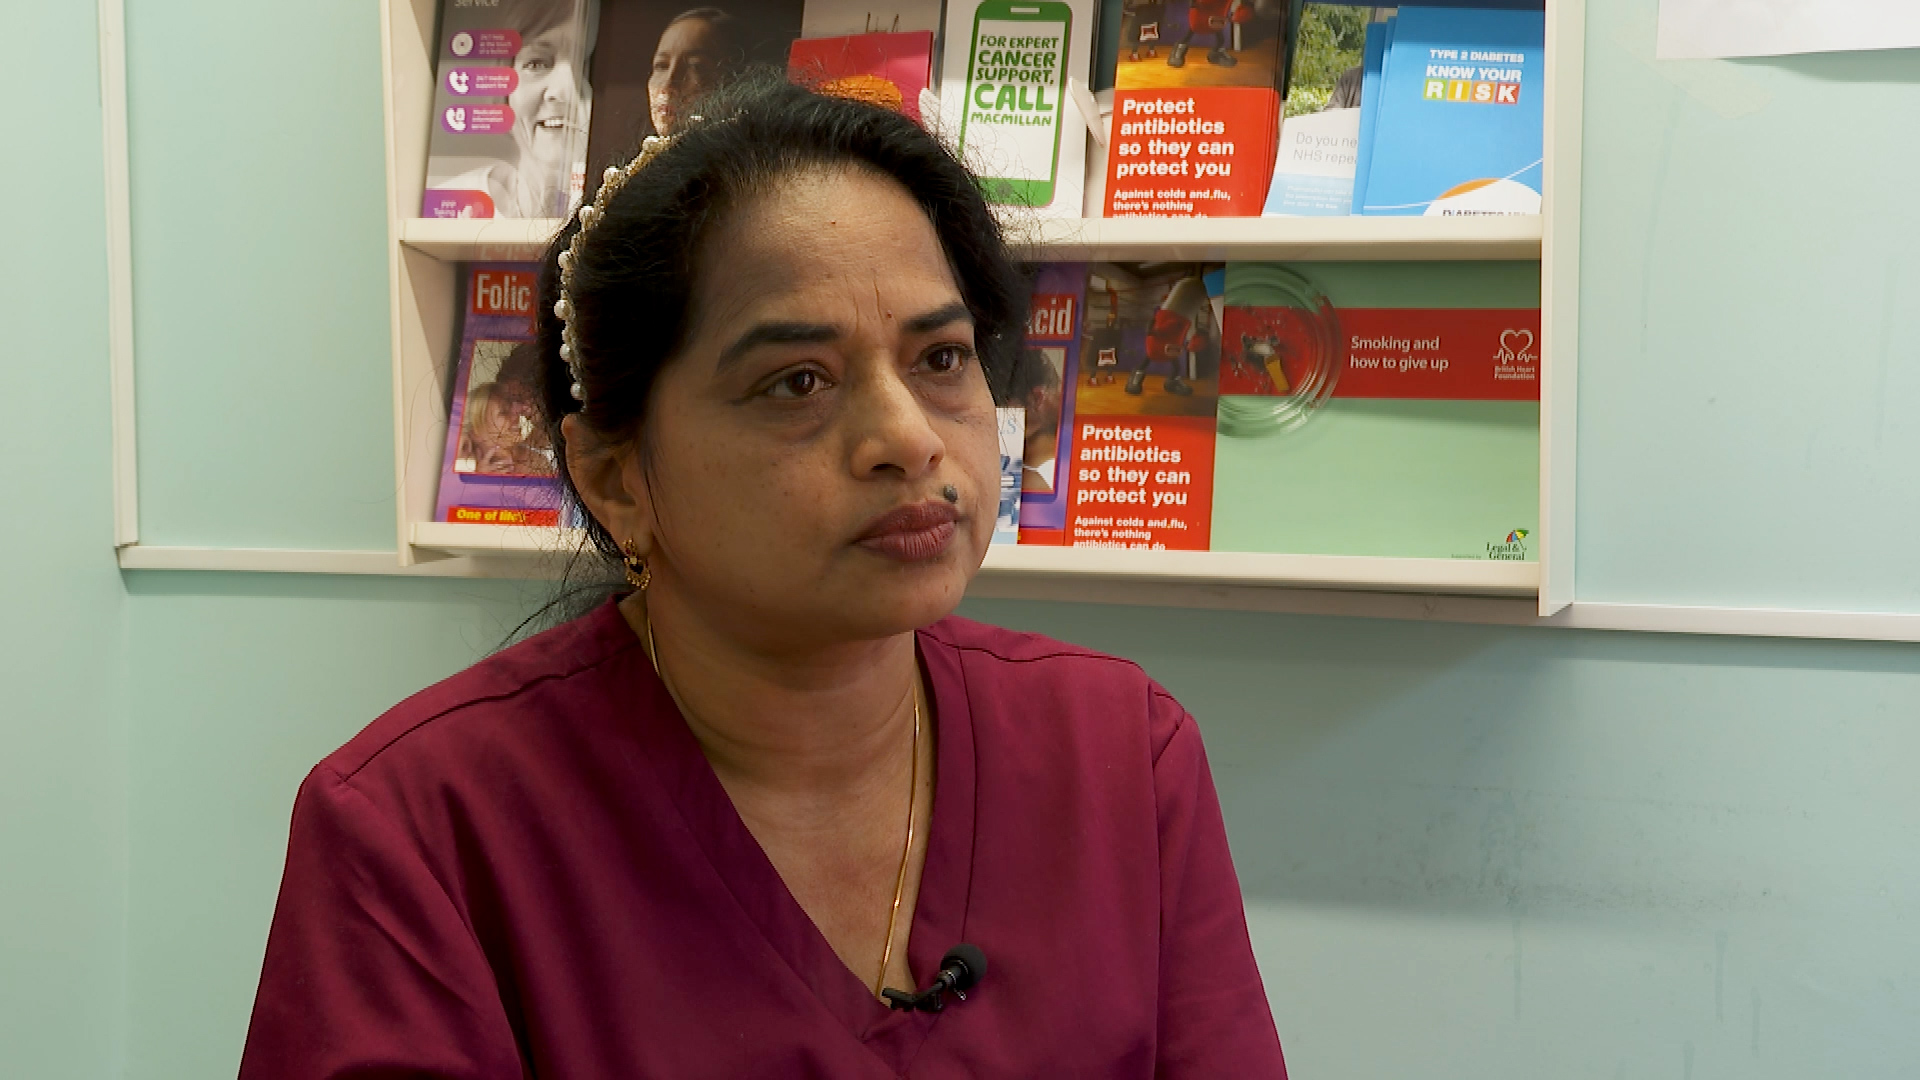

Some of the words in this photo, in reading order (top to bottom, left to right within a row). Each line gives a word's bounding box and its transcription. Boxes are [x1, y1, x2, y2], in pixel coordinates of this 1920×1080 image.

[980, 35, 1007, 47] FOR
[1010, 36, 1059, 48] EXPERT
[978, 50, 1056, 68] CANCER
[1430, 49, 1458, 60] TYPE
[1461, 51, 1468, 60] 2
[1470, 52, 1524, 63] DIABETES
[975, 68, 1054, 85] SUPPORT,
[1426, 65, 1475, 79] KNOW
[1479, 68, 1522, 82] YOUR
[974, 83, 1053, 112] CALL
[1426, 81, 1516, 102] RISK
[1123, 98, 1195, 115] Protect
[970, 112, 1051, 126] MACMILLAN
[1120, 118, 1225, 135] antibiotics
[1118, 142, 1141, 156] so
[1148, 139, 1191, 158] they
[1198, 142, 1234, 156] can
[1296, 132, 1312, 145] Do
[1316, 136, 1338, 148] you
[1294, 150, 1322, 162] NHS
[1116, 160, 1189, 179] protect
[1195, 163, 1231, 178] you
[1114, 189, 1154, 201] Against
[1157, 188, 1186, 199] colds
[1113, 200, 1149, 210] there's
[1152, 200, 1194, 212] nothing
[477, 274, 531, 312] Folic
[1351, 335, 1410, 353] Smoking
[1413, 336, 1440, 350] and
[1350, 354, 1380, 369] how
[1382, 356, 1396, 369] to
[1400, 356, 1428, 372] give
[1431, 358, 1449, 372] up
[1082, 423, 1152, 441] Protect
[1080, 446, 1181, 463] antibiotics
[1078, 469, 1101, 482] so
[1107, 466, 1149, 486] they
[1155, 470, 1190, 484] can
[1077, 488, 1146, 506] protect
[1152, 492, 1188, 508] you
[457, 509, 481, 520] One
[484, 510, 497, 520] of
[1075, 515, 1113, 527] Against
[1116, 516, 1144, 527] colds
[1074, 527, 1109, 537] there's
[1112, 529, 1151, 540] nothing
